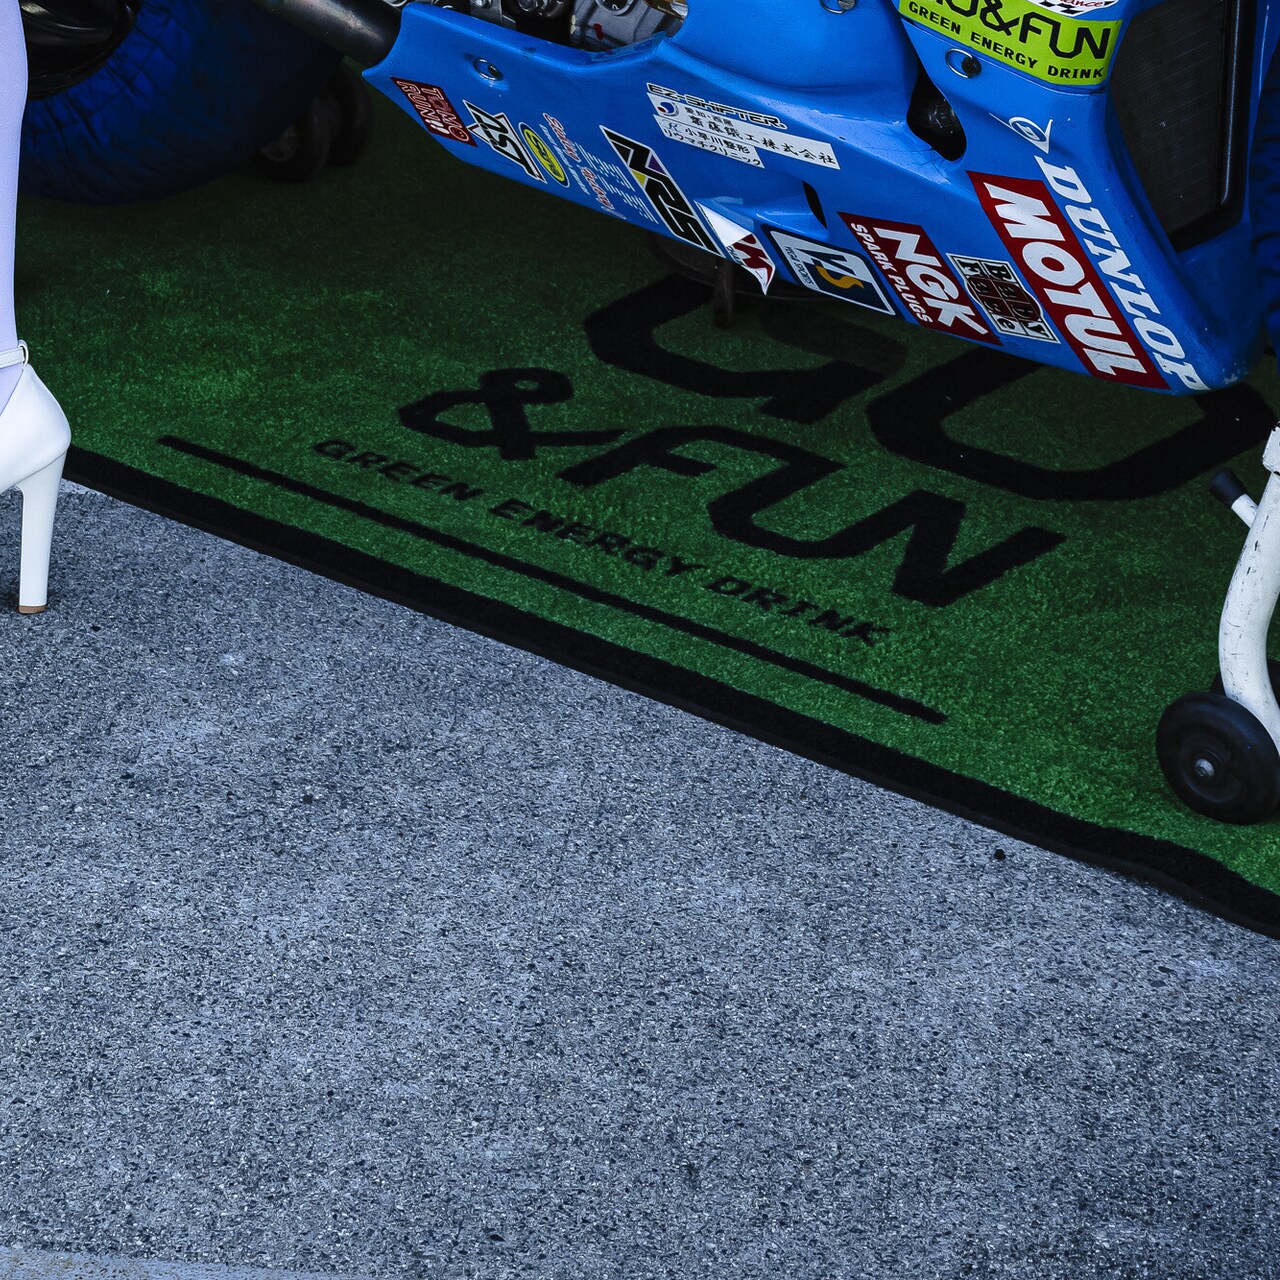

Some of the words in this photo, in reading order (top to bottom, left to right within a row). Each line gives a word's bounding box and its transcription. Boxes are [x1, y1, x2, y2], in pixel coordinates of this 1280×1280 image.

[908, 0, 962, 35] GREEN
[970, 34, 1040, 70] ENERGY
[1047, 64, 1105, 80] DRINK
[850, 222, 897, 276] SPARK
[888, 276, 933, 324] PLUGS
[873, 227, 988, 335] NGK
[983, 182, 1147, 376] MOTUL
[1034, 155, 1210, 390] DUNLOP
[313, 436, 488, 507] GREEN
[486, 497, 710, 581] ENERGY
[704, 570, 895, 647] DRINK
